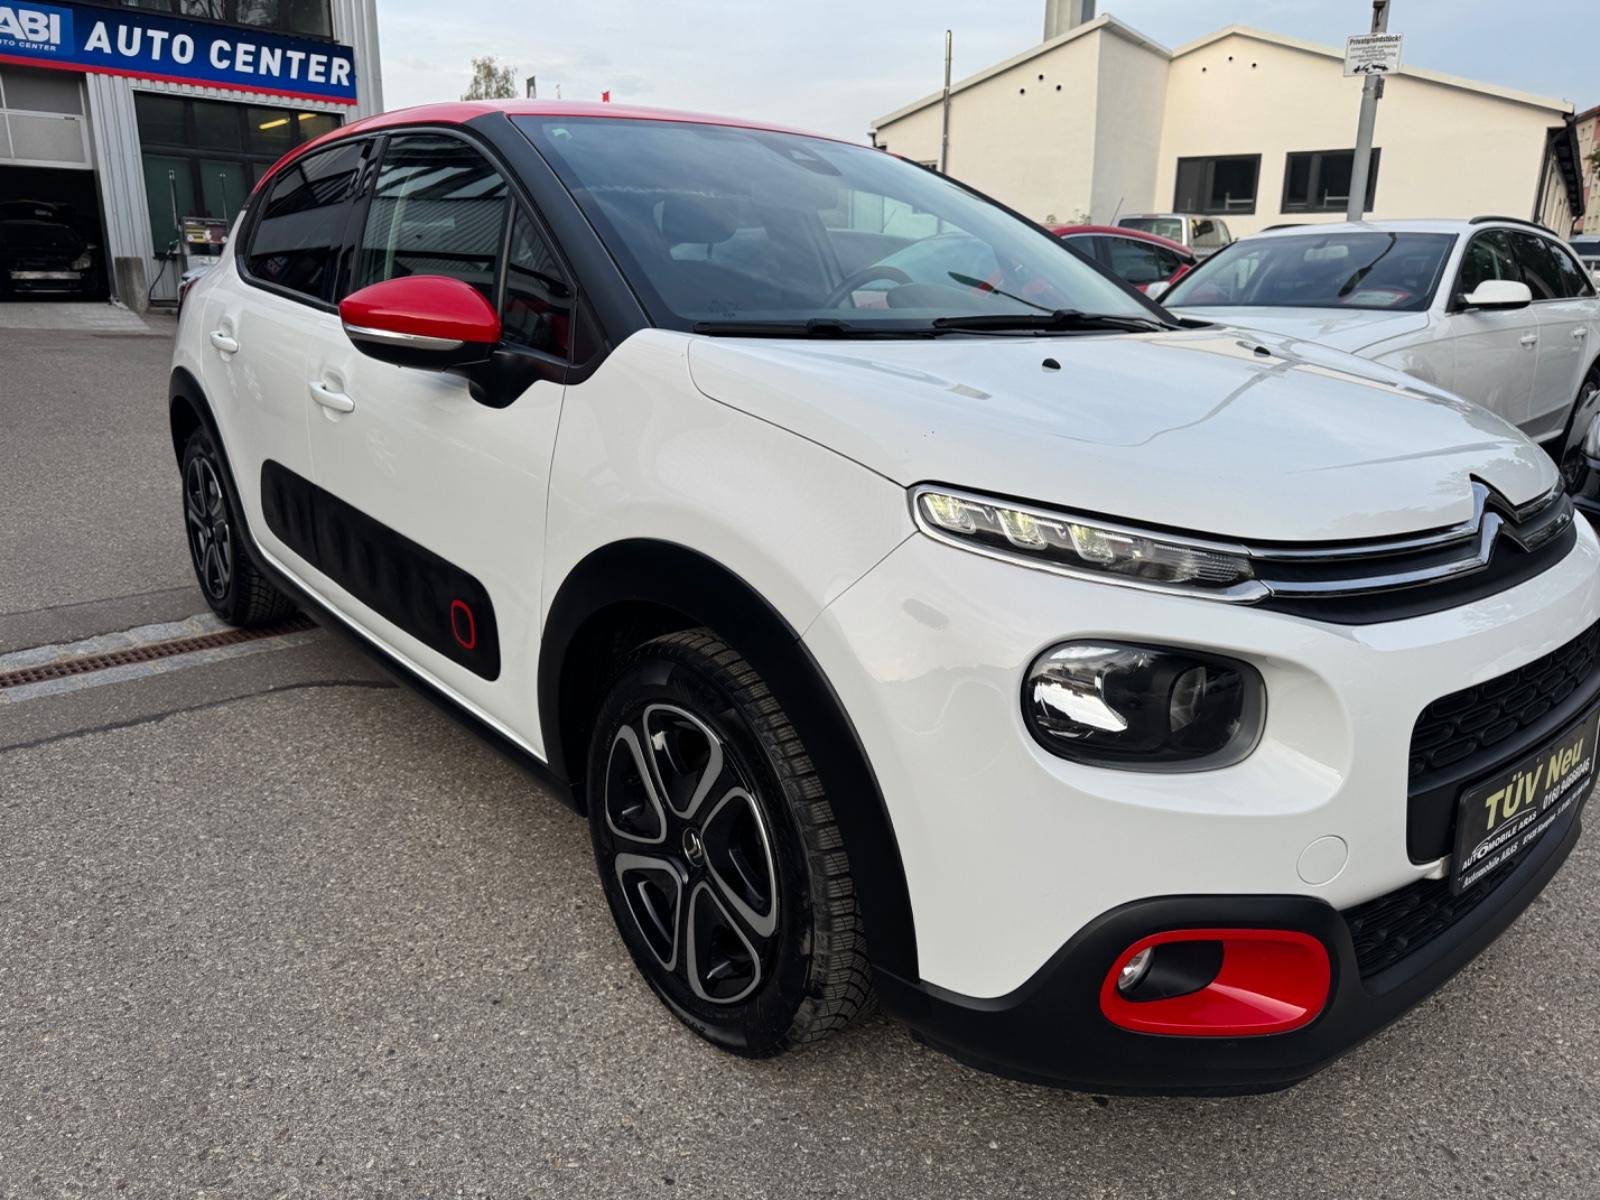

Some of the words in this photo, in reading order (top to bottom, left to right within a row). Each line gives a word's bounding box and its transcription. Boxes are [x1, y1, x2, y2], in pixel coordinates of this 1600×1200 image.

[0, 6, 61, 45] ABI
[18, 41, 57, 52] CENTER
[84, 21, 195, 65] AUTO
[209, 39, 351, 87] CENTER
[1485, 763, 1544, 831] TÜV
[1545, 738, 1584, 790] Neu
[1462, 823, 1517, 871] AUTOMOBILE
